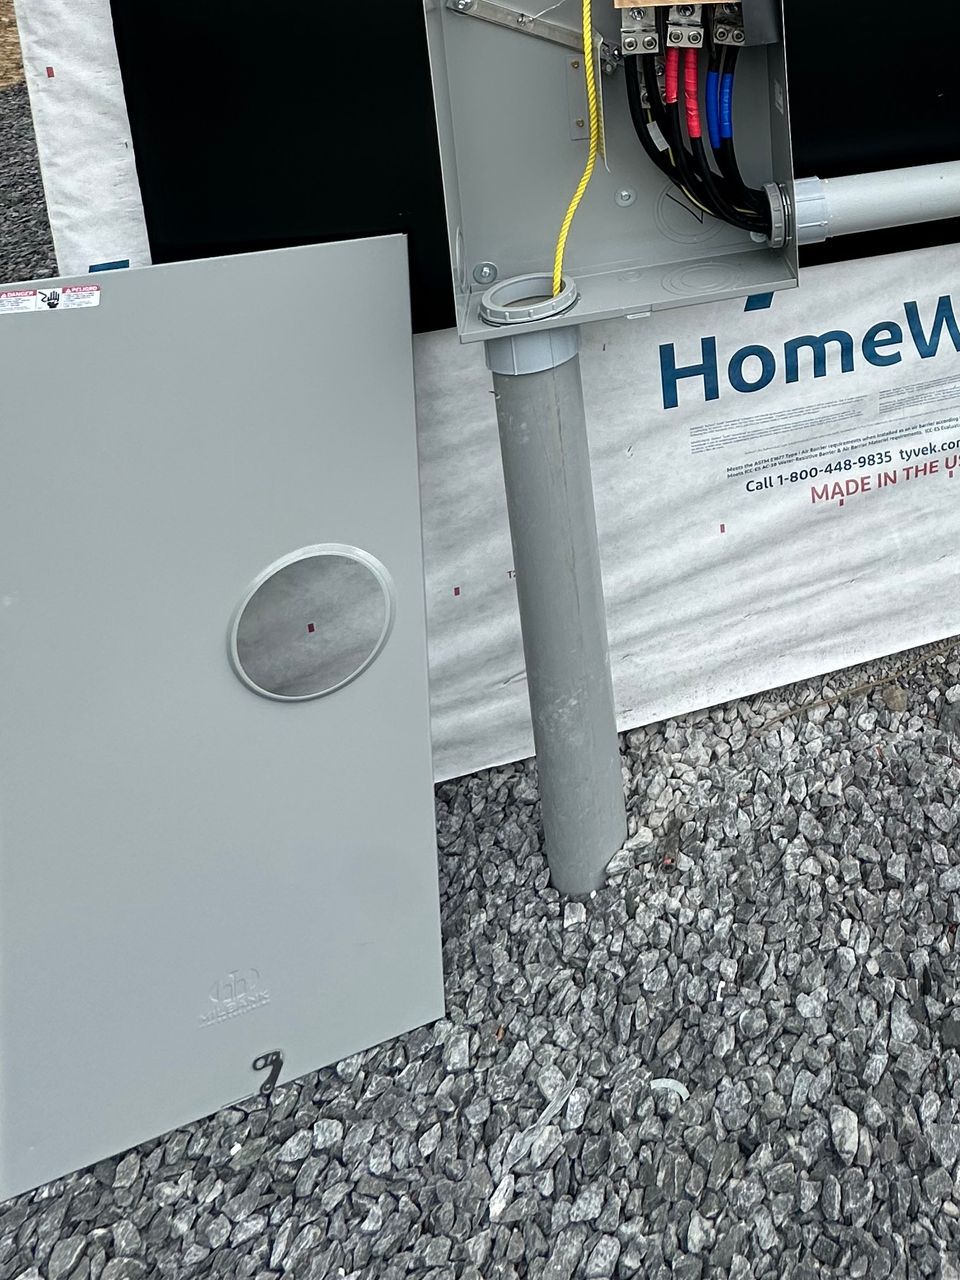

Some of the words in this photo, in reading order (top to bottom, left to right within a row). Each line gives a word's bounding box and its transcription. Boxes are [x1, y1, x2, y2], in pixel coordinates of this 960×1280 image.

[746, 475, 774, 493] Call
[777, 451, 892, 485] 1-800-448-9835
[810, 475, 872, 504] MADE
[877, 469, 897, 489] IN
[903, 459, 939, 481] THE
